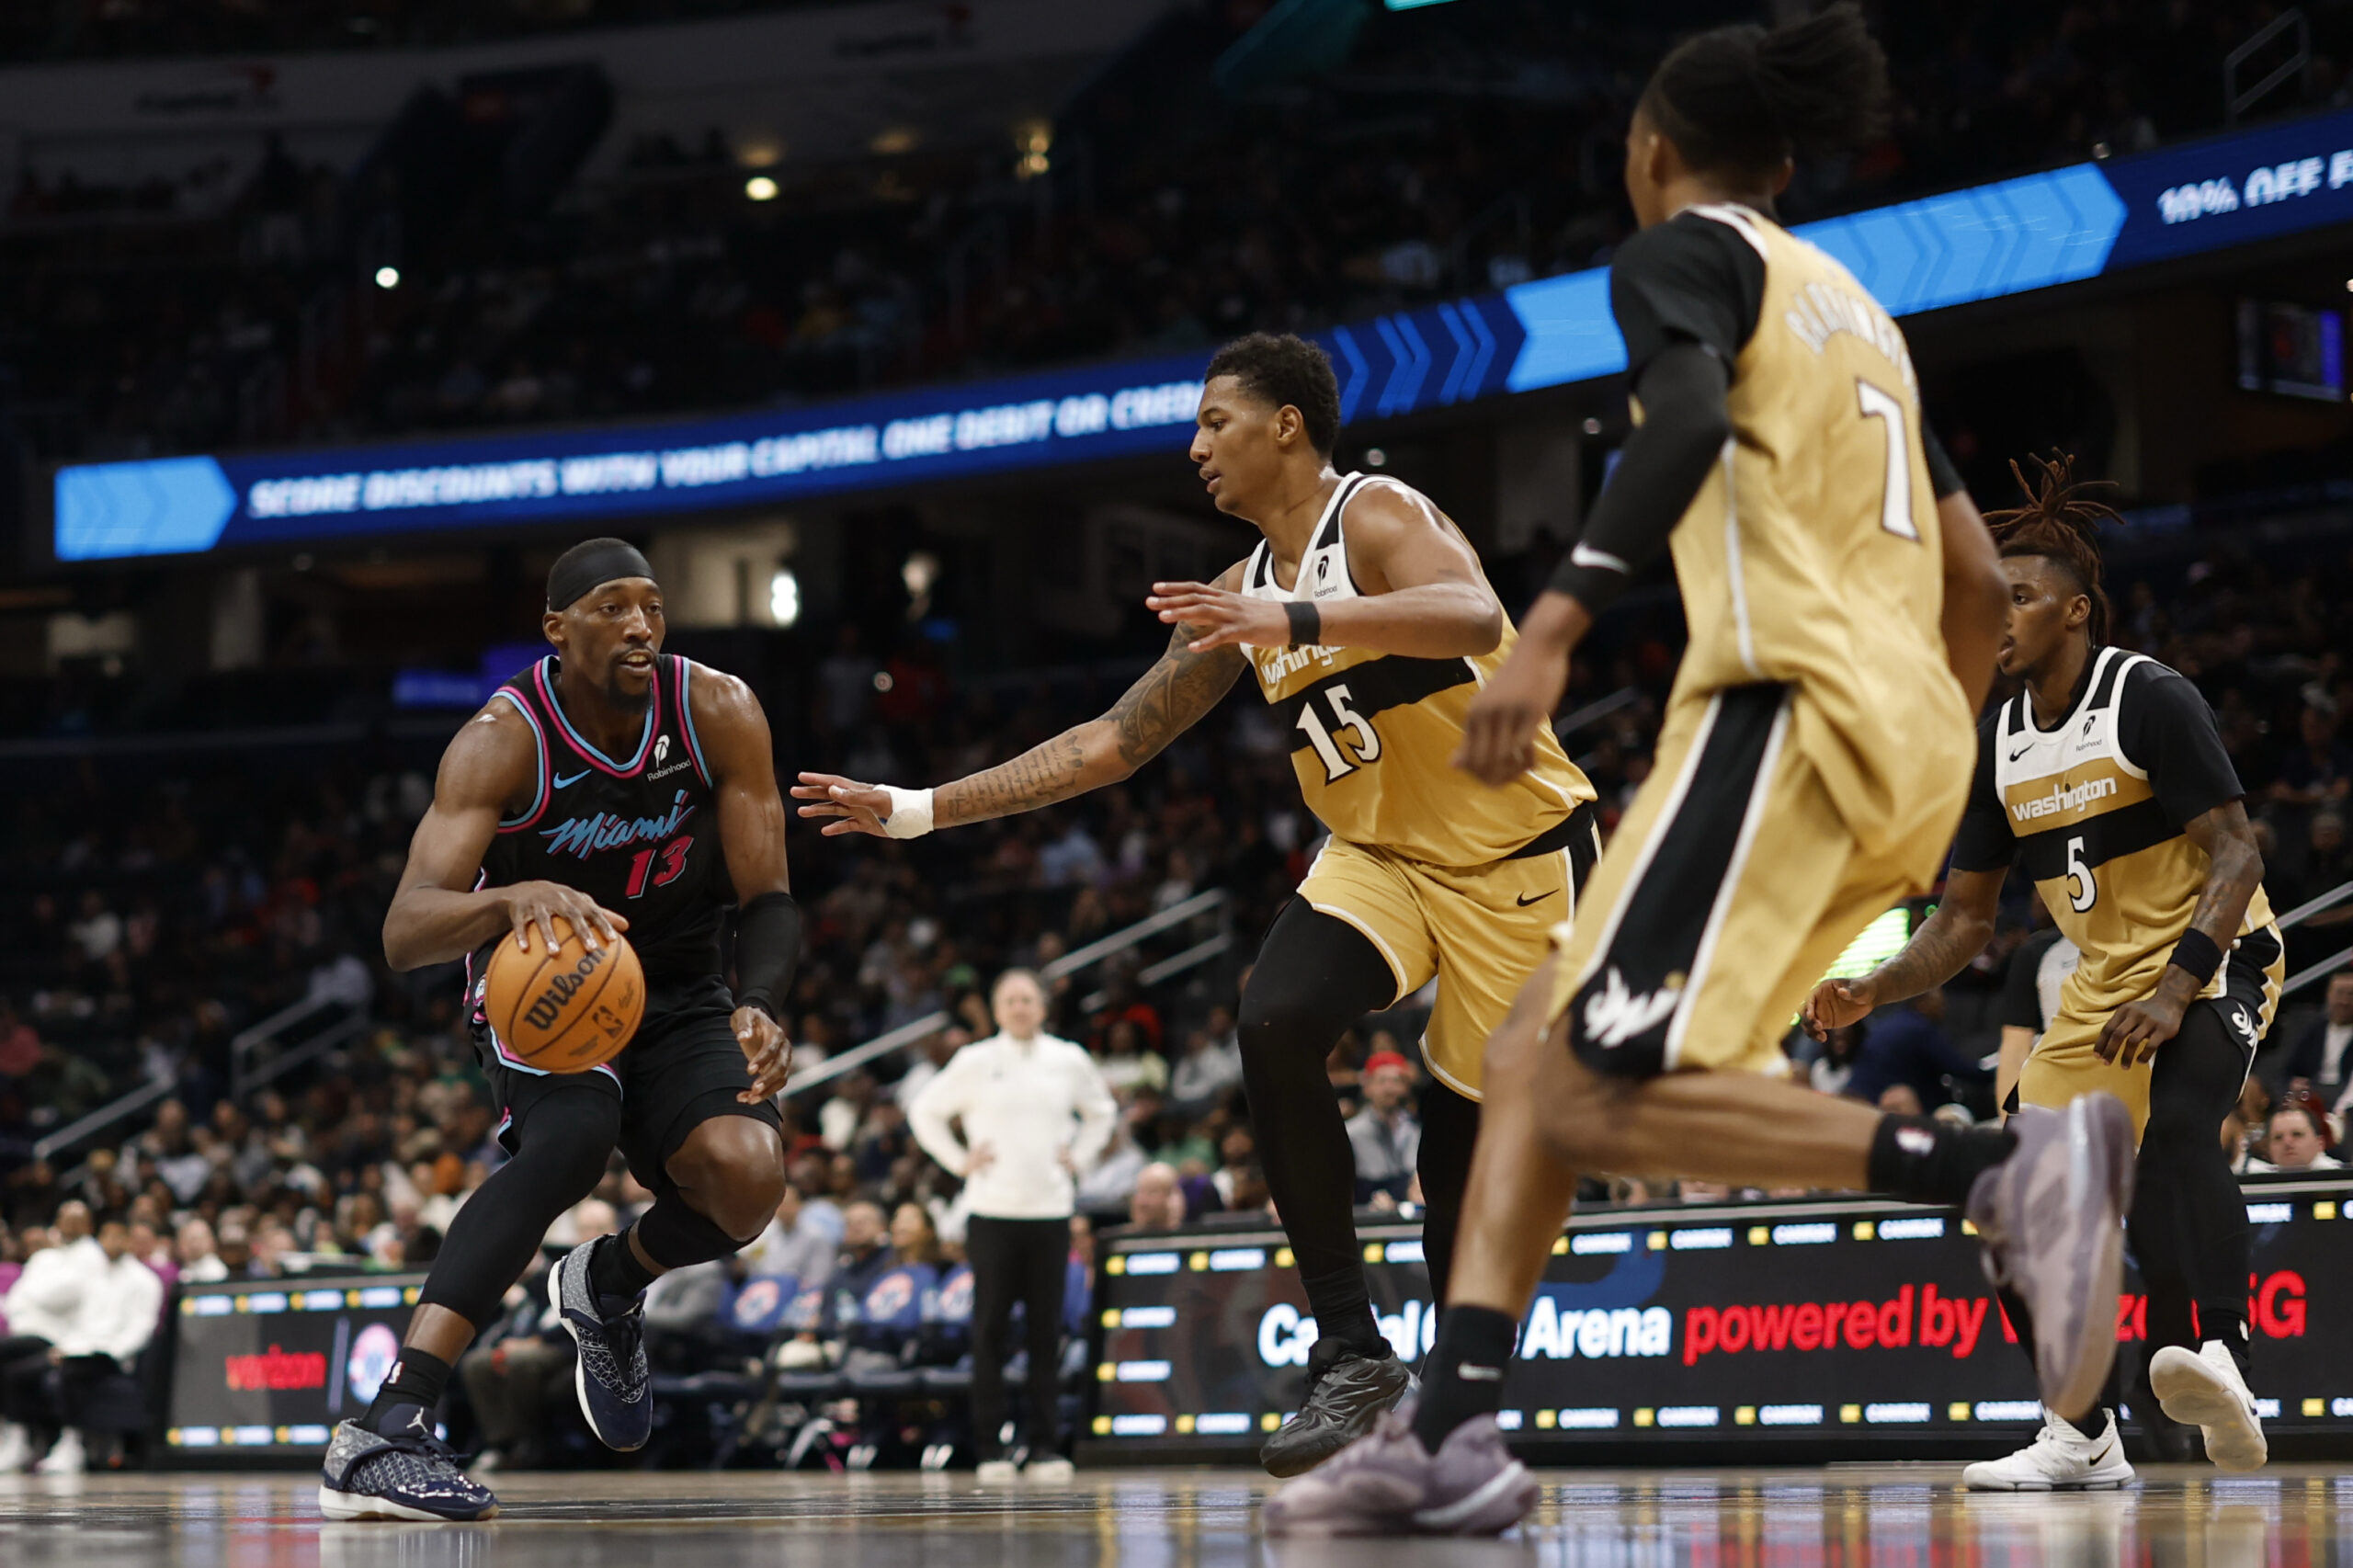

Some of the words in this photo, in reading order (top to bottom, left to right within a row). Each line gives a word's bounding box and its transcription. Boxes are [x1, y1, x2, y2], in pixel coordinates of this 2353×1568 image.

[2244, 156, 2325, 208] OFF
[248, 472, 362, 518] SCORE
[363, 458, 558, 510] DISCOUNTS
[562, 450, 657, 494] WITH
[661, 441, 750, 487] YOUR
[751, 425, 879, 477] CAPITAL
[882, 413, 955, 459] ONE
[956, 399, 1056, 449] DEBIT
[1055, 393, 1108, 437] OR
[1855, 375, 1923, 542] 7
[647, 758, 691, 782] Robinhood
[1295, 682, 1382, 786] 15
[539, 789, 698, 861] Miami
[2011, 777, 2118, 822] washington
[625, 835, 695, 900] 13
[2066, 835, 2097, 914] 5
[523, 947, 608, 1032] Wilson
[1519, 1295, 1672, 1361] Arena
[1683, 1283, 1915, 1367] powered
[1918, 1282, 1990, 1359] by
